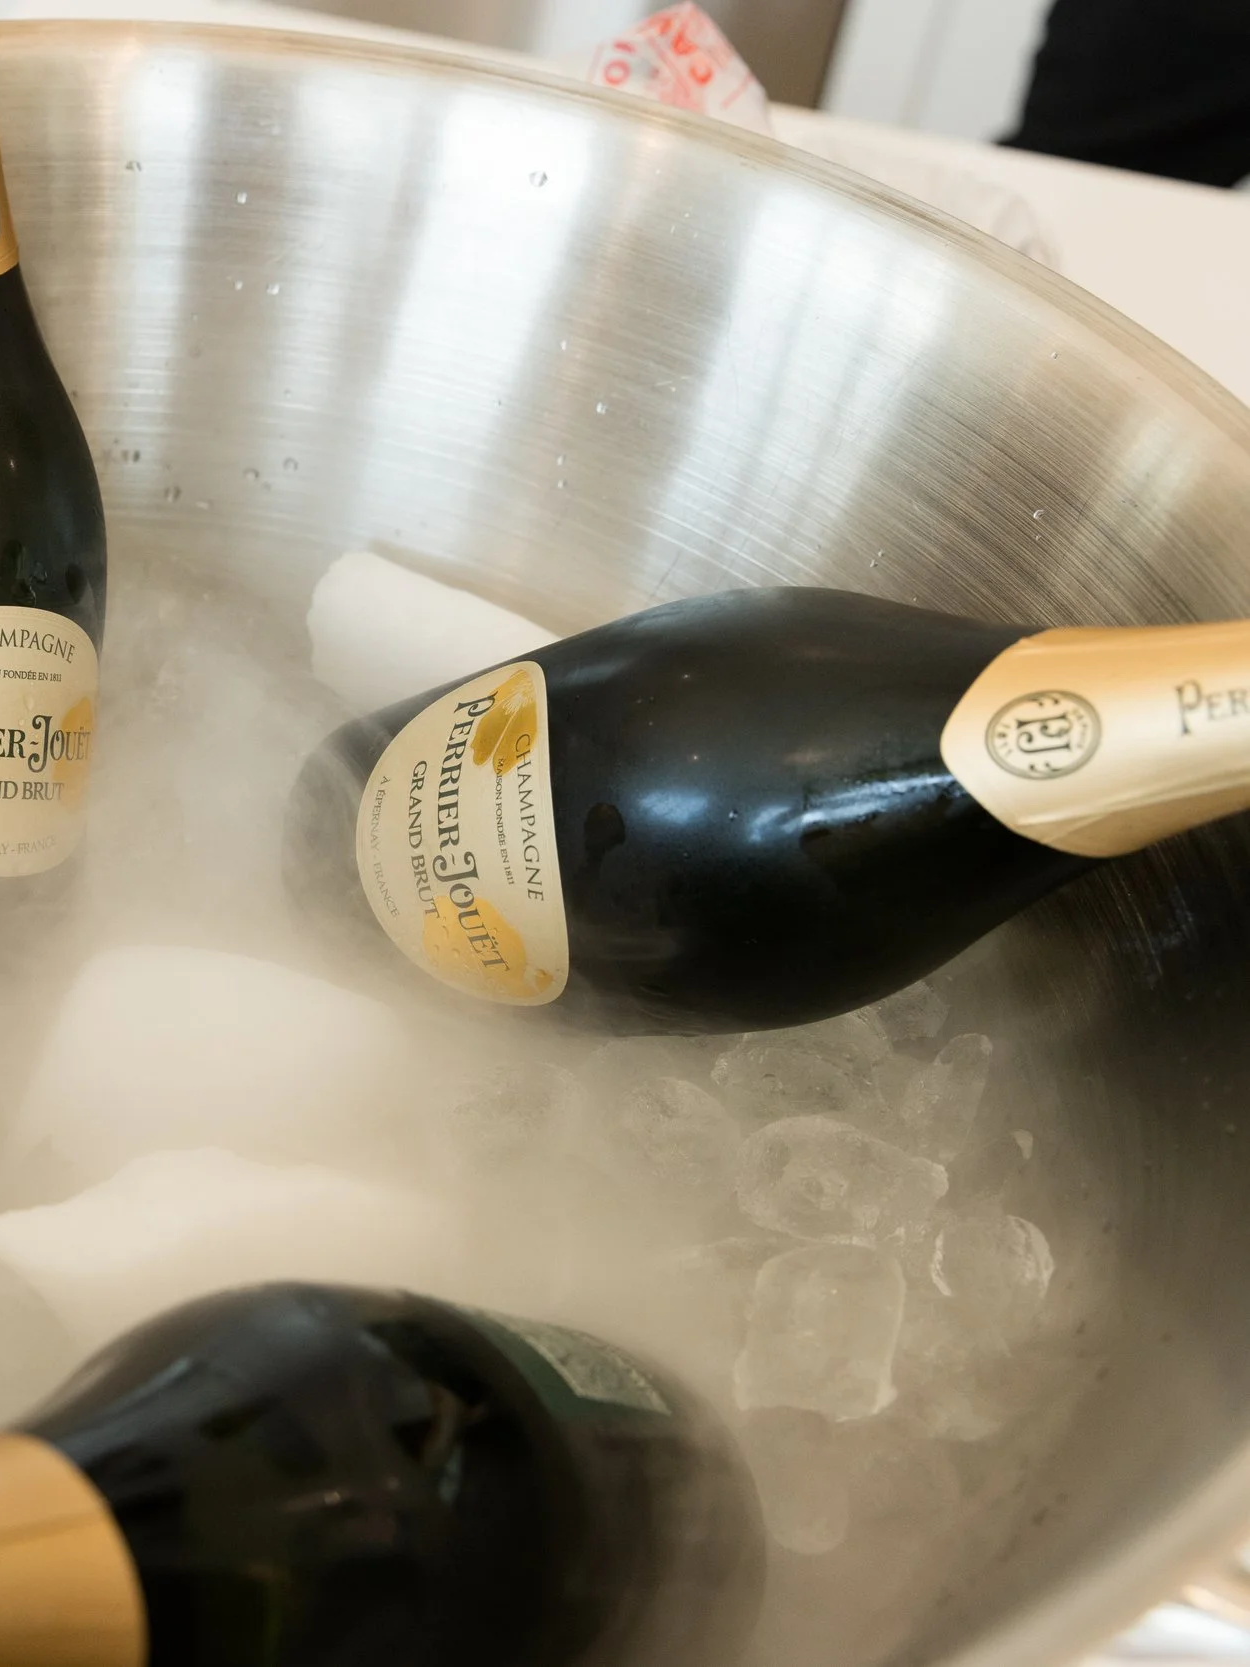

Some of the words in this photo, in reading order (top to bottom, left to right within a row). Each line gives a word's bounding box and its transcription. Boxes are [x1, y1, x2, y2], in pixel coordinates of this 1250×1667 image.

[3, 669, 37, 681] FONDÉE
[38, 672, 49, 681] EN
[49, 672, 62, 683] 1811
[21, 780, 65, 801] BRUT
[494, 757, 506, 800] MAISON
[370, 789, 386, 852] ÉPERNAY
[407, 760, 428, 850] GRAND
[495, 802, 507, 846] FONDÉE
[514, 732, 545, 902] CHAMPAGNE
[432, 690, 511, 972] PERRIER-JOUËT
[500, 848, 510, 863] EN
[372, 861, 400, 918] FRANCE
[410, 853, 441, 920] BRUT
[504, 865, 515, 885] 1811
